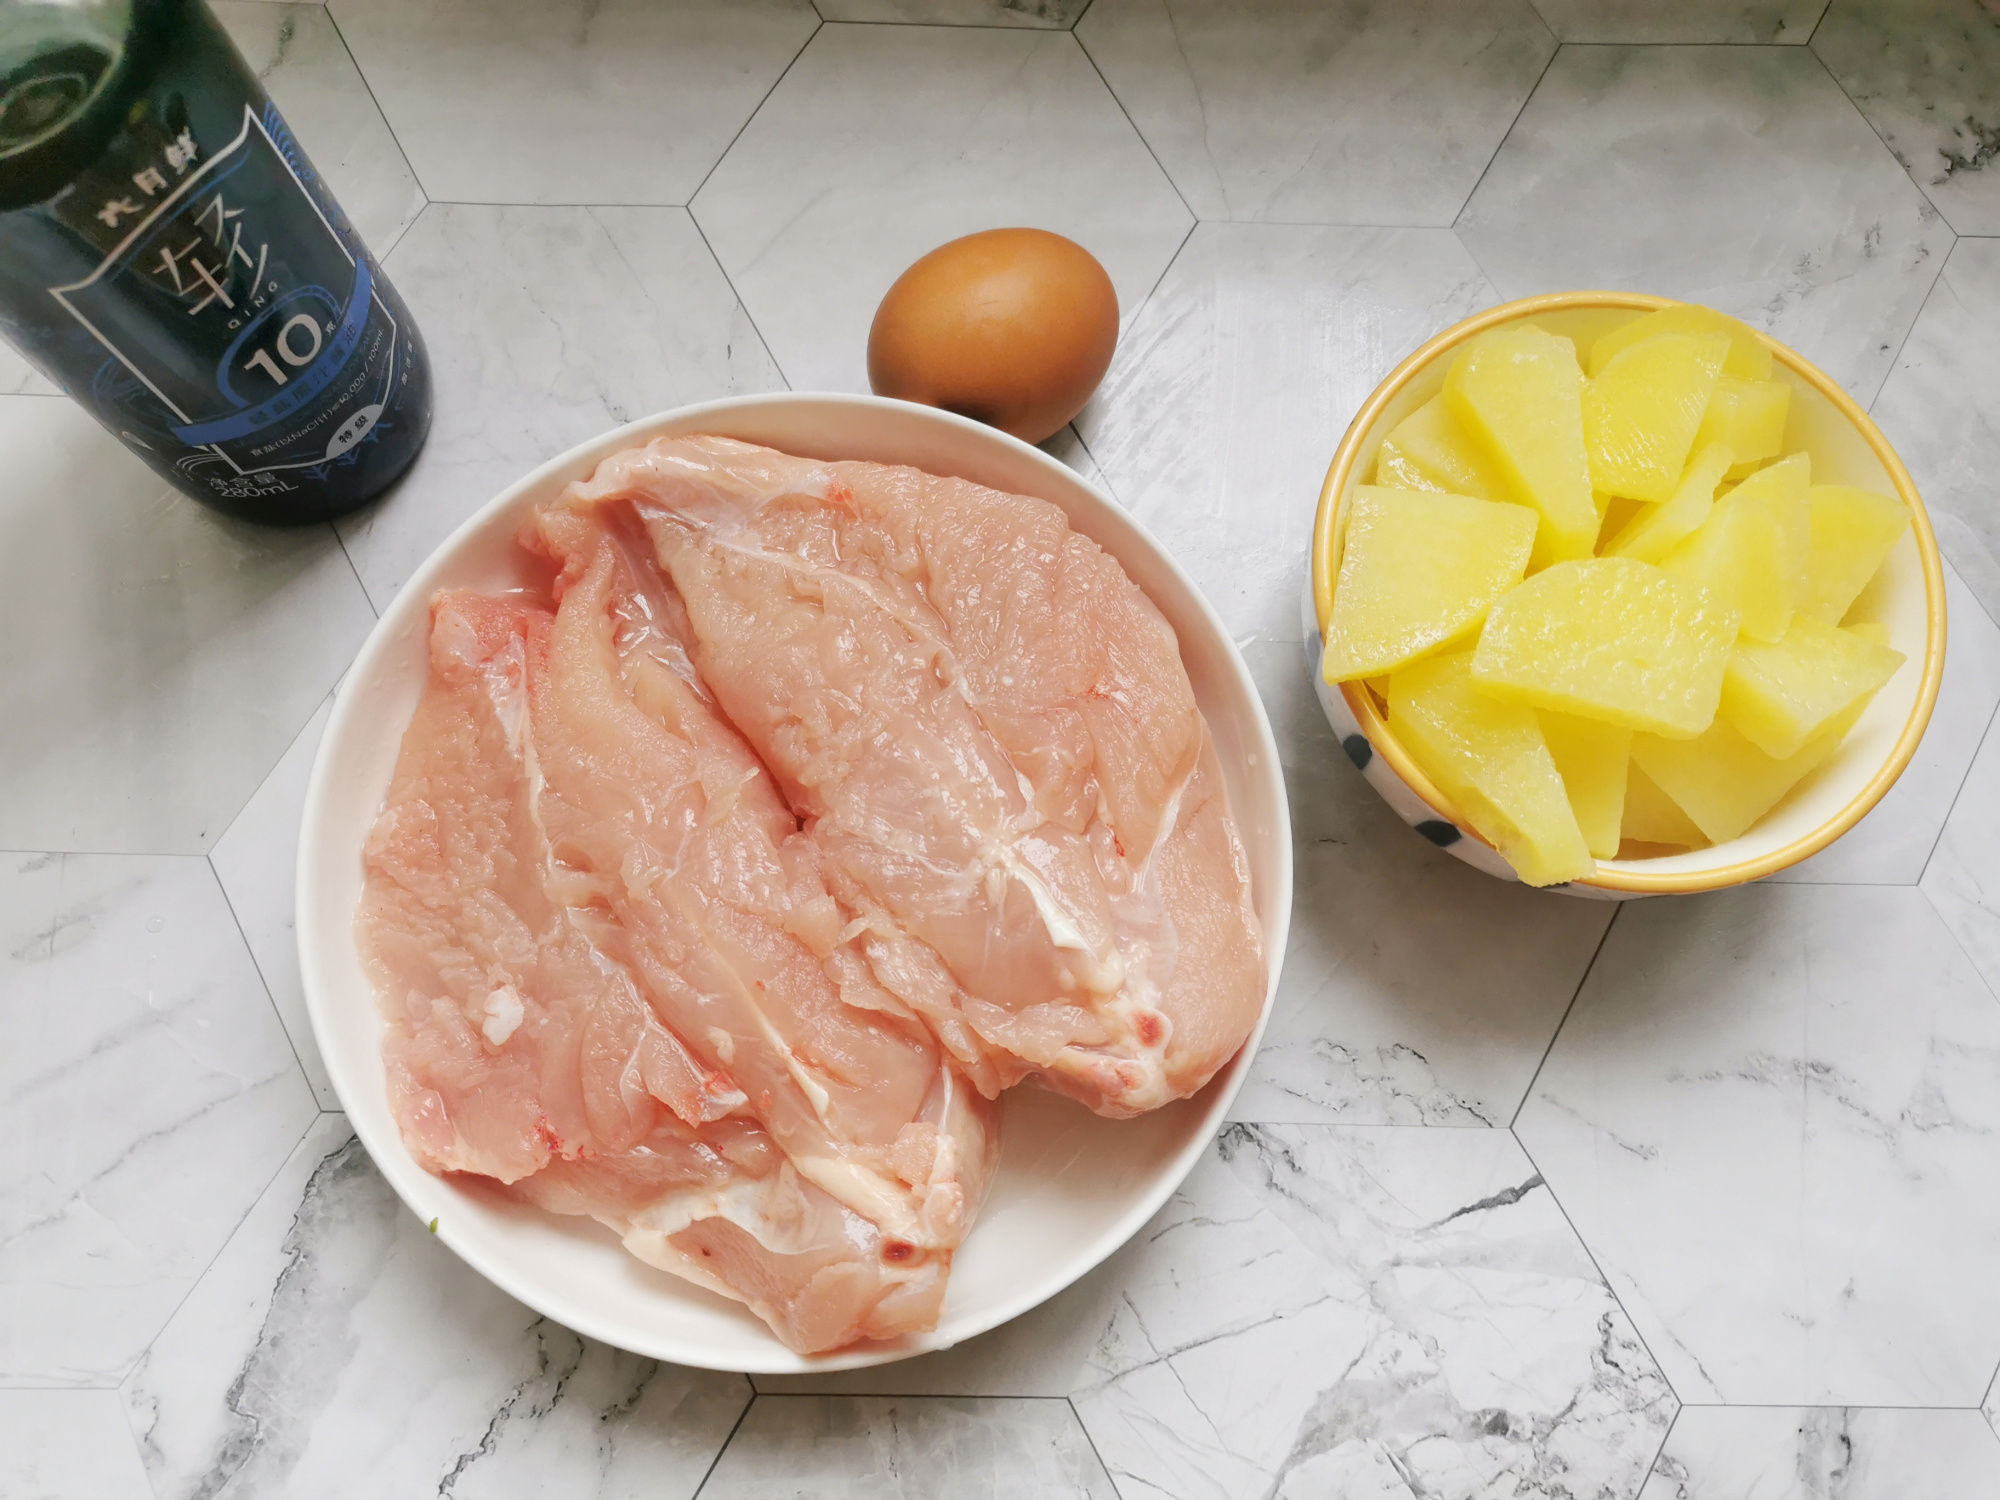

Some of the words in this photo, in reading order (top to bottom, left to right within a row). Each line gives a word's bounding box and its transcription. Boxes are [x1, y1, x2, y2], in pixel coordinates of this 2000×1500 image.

[228, 281, 278, 329] QING
[338, 414, 369, 444] 特级
[215, 480, 299, 498] 280mL
